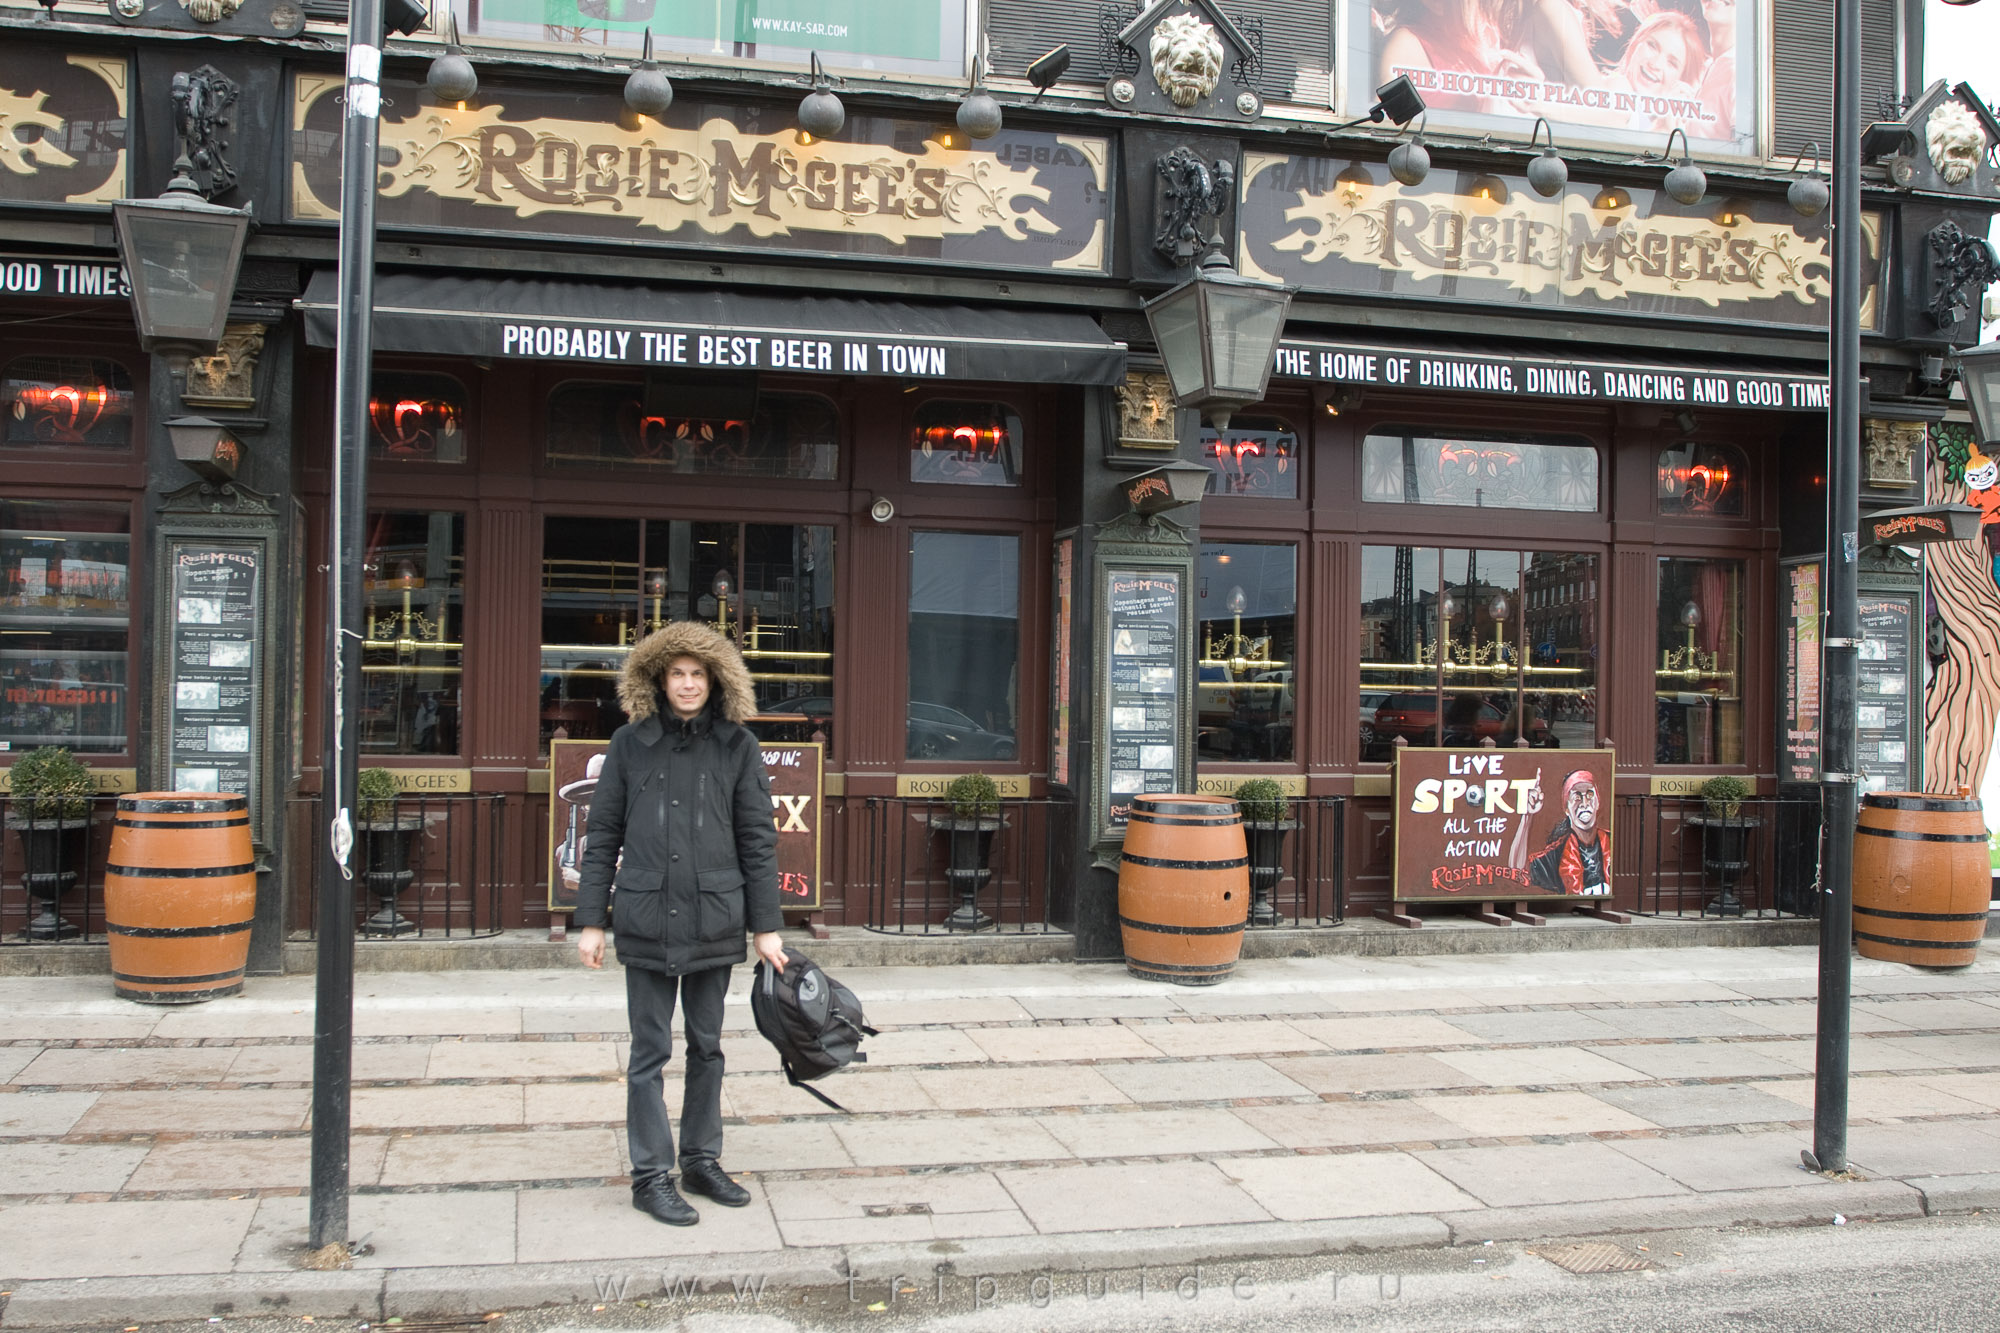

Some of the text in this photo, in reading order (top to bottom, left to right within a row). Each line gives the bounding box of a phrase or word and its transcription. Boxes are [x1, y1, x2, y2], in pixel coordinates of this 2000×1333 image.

[752, 17, 848, 38] WWW.KAY-SAR.COM
[1393, 67, 1716, 121] THE HOTTEST PLACE IN TOWN...
[474, 124, 683, 212] ROSIE
[1379, 199, 1546, 276] ROSIE
[504, 325, 946, 375] PROBABLY THE BEST BEER IN TOWN
[1275, 349, 1312, 376] THE
[1320, 352, 1378, 382] HOME
[1386, 357, 1411, 384] OF
[1420, 359, 1518, 394] DRINKING,
[1526, 367, 1598, 397] DINING,
[1604, 371, 1685, 401] DANCING
[1693, 377, 1729, 404] AND
[1736, 380, 1784, 406] GOOD
[1660, 780, 1696, 792] ROSIE
[1443, 816, 1508, 835] ALL THE
[1444, 838, 1502, 858] ACTION
